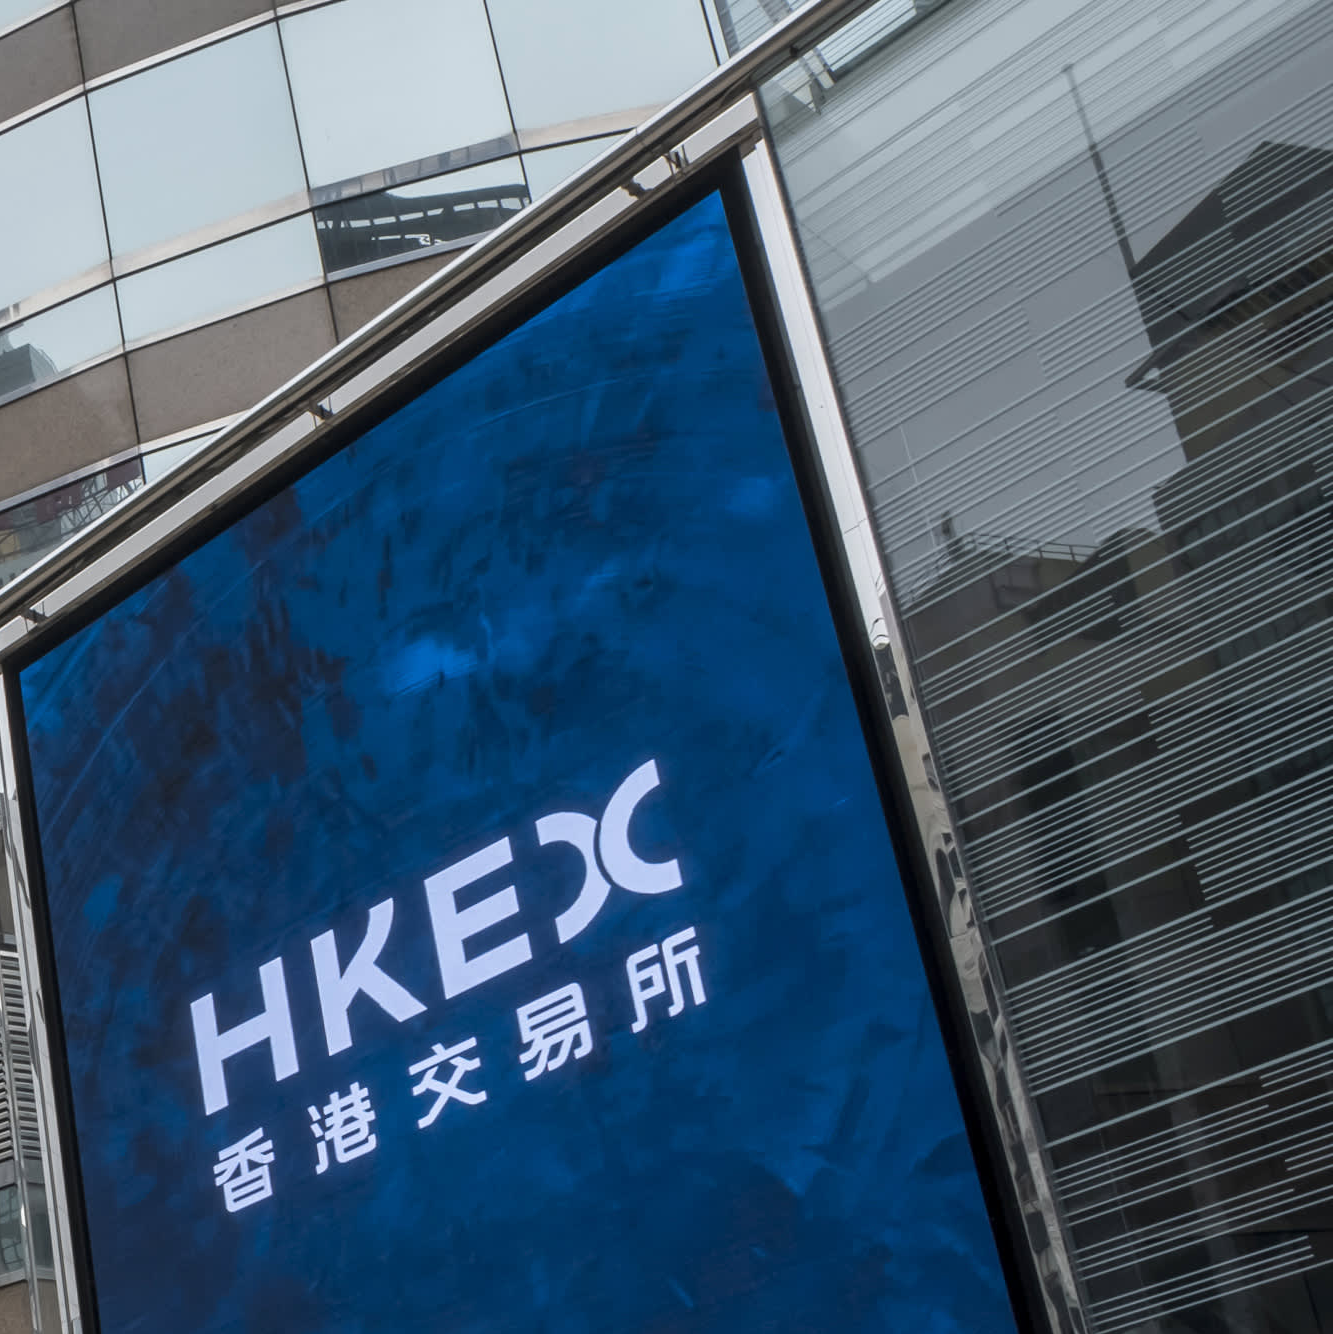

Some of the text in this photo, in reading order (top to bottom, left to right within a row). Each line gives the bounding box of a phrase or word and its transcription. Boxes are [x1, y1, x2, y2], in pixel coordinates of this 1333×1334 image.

[190, 759, 683, 1116] HKEX
[212, 926, 707, 1213] 香港交易所
